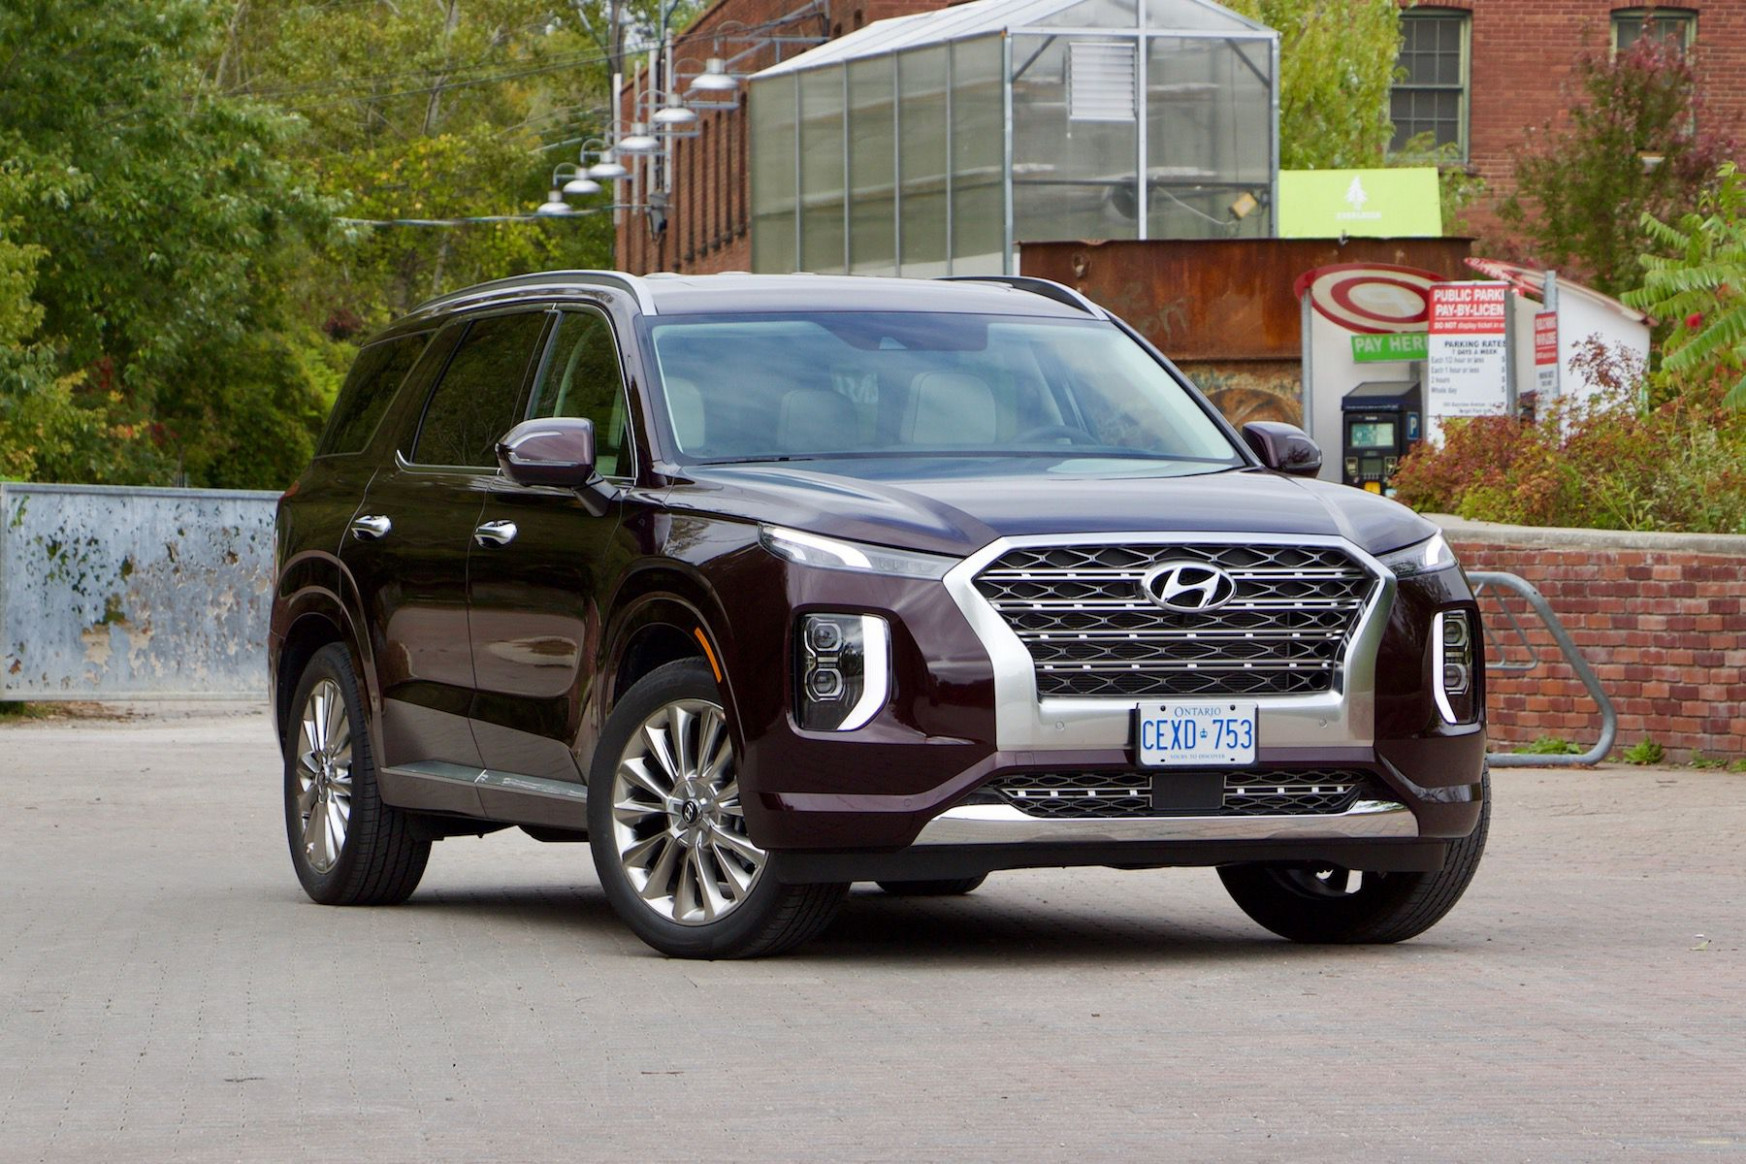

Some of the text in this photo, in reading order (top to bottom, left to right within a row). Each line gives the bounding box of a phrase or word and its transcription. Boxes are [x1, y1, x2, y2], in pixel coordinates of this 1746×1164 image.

[1433, 288, 1519, 302] PUBLIC PARKI
[1435, 303, 1505, 317] PAY-BY-LICEN
[1444, 321, 1457, 330] NOT
[1354, 336, 1383, 354] PAY
[1444, 340, 1506, 348] PARKING RATES
[1174, 706, 1222, 717] ONTARIO
[1142, 719, 1252, 750] CEXD 753
